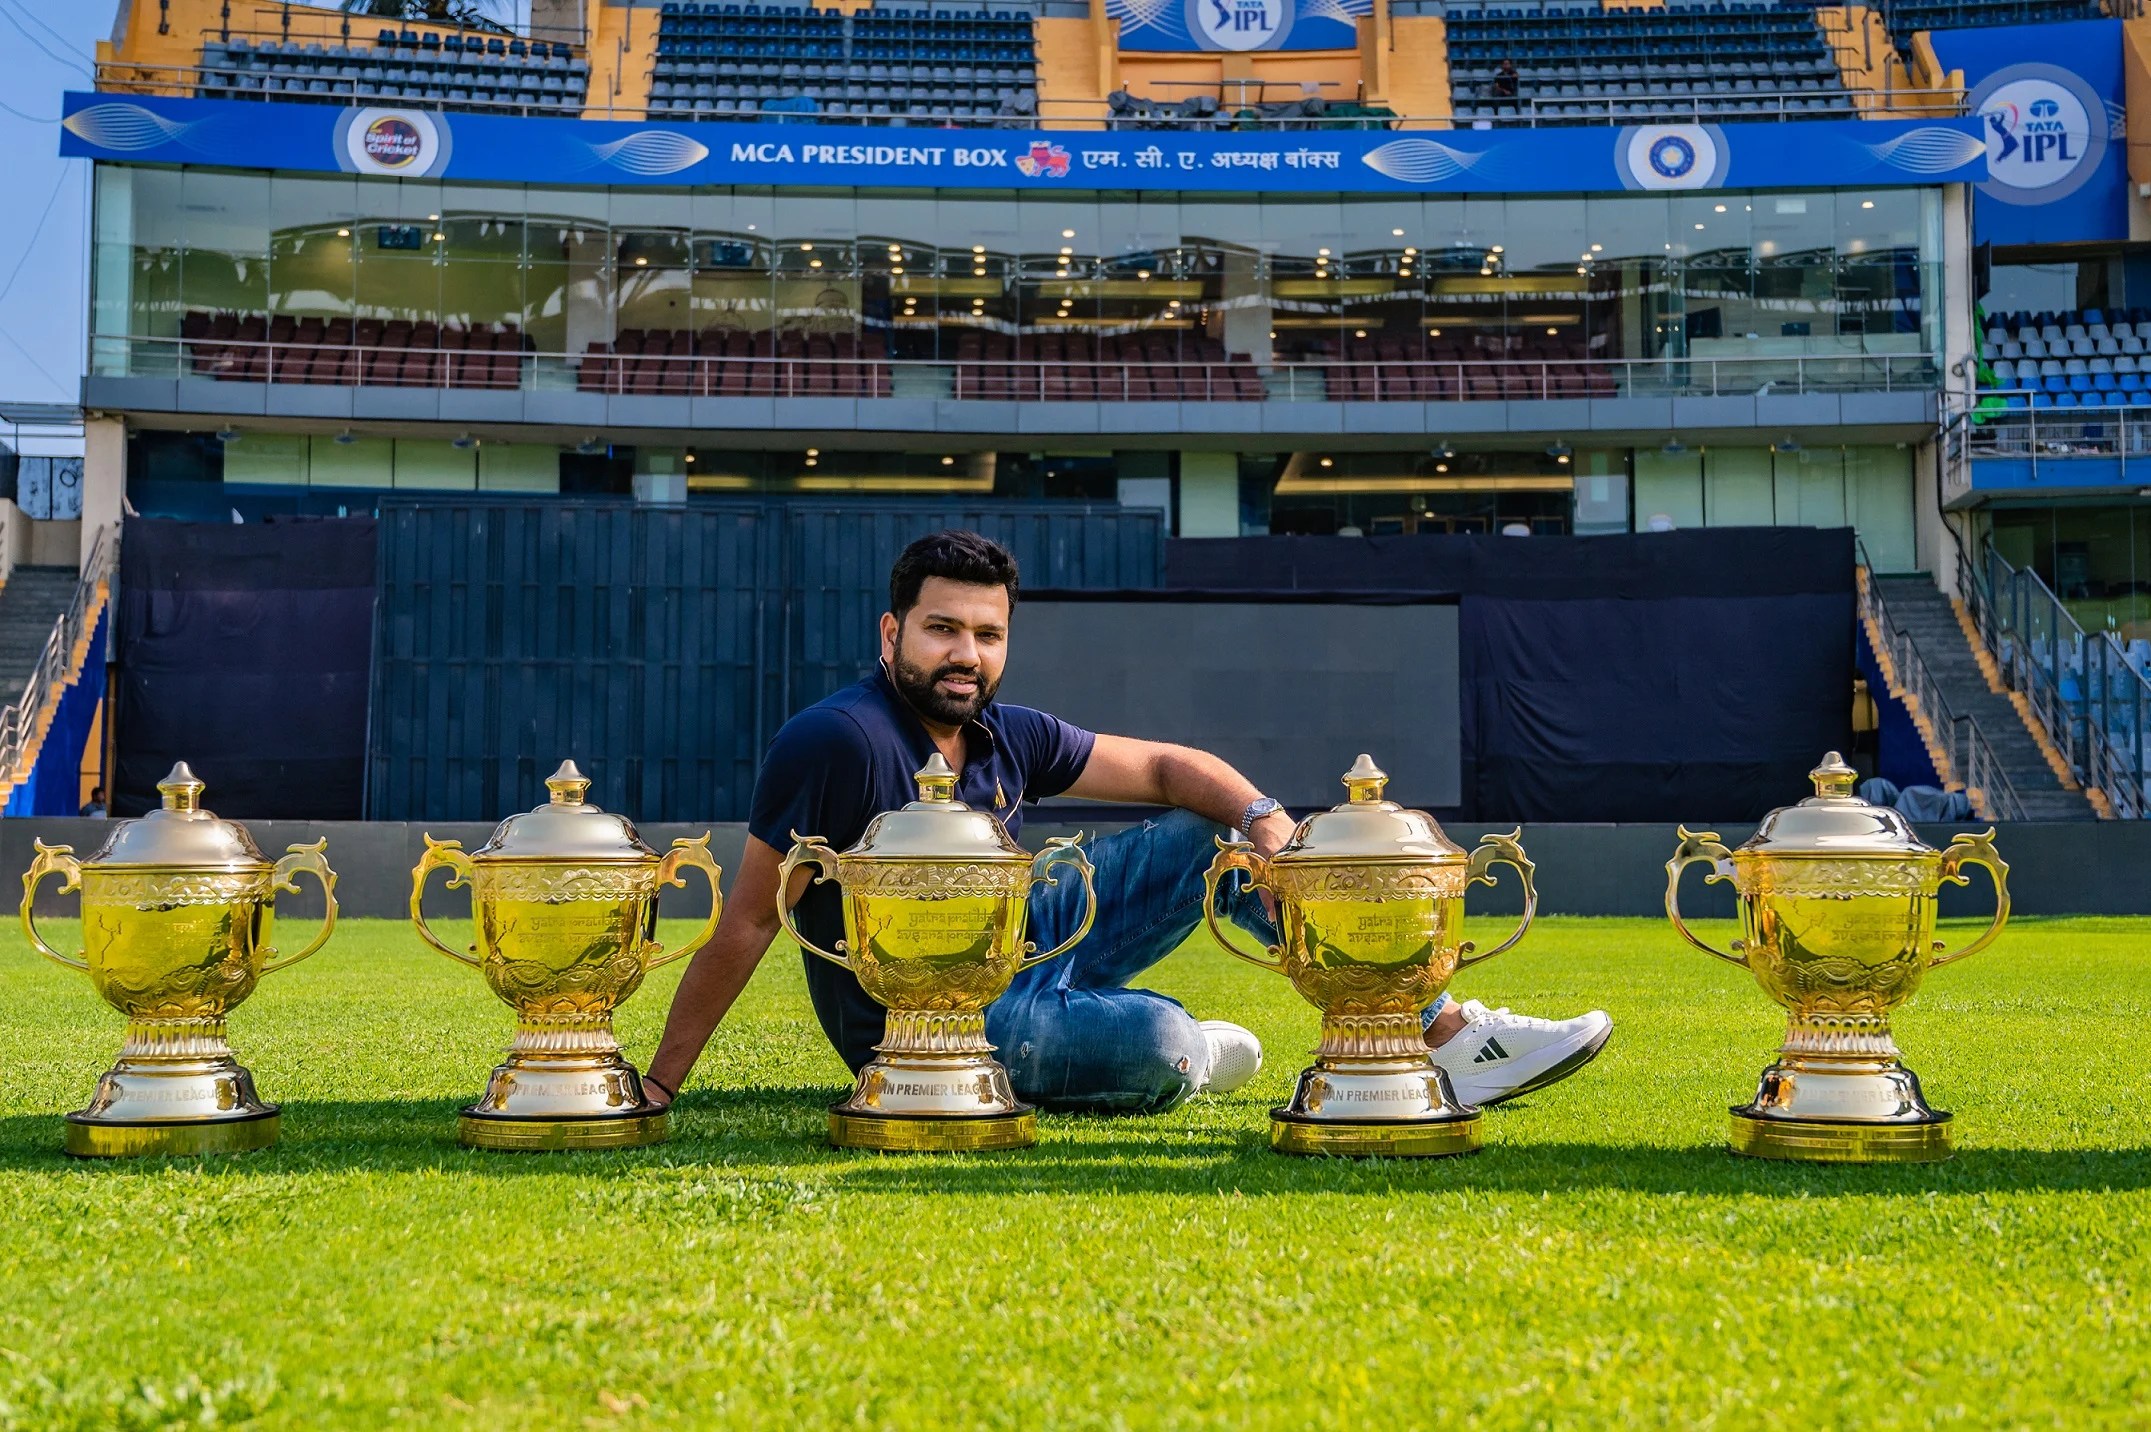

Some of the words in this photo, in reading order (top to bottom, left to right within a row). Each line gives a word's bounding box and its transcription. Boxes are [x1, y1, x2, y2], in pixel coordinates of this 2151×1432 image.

[1235, 10, 1273, 31] IPL
[2025, 121, 2064, 132] TATA
[366, 132, 403, 144] Spirit
[403, 136, 417, 145] of
[367, 143, 419, 156] Cricket
[730, 143, 795, 163] MCA
[802, 145, 946, 166] PRESIDENT
[953, 149, 1008, 167] BOX
[2023, 133, 2077, 162] IPL
[1210, 150, 1280, 171] अध्यक्ष
[1284, 147, 1341, 169] बॉक्स
[909, 909, 945, 927] yatra
[1357, 913, 1393, 930] yatra
[123, 1089, 173, 1102] PREMIER
[896, 1083, 948, 1096] PREMIER
[1347, 1090, 1400, 1102] PREMIER
[1402, 1088, 1433, 1102] LEAG
